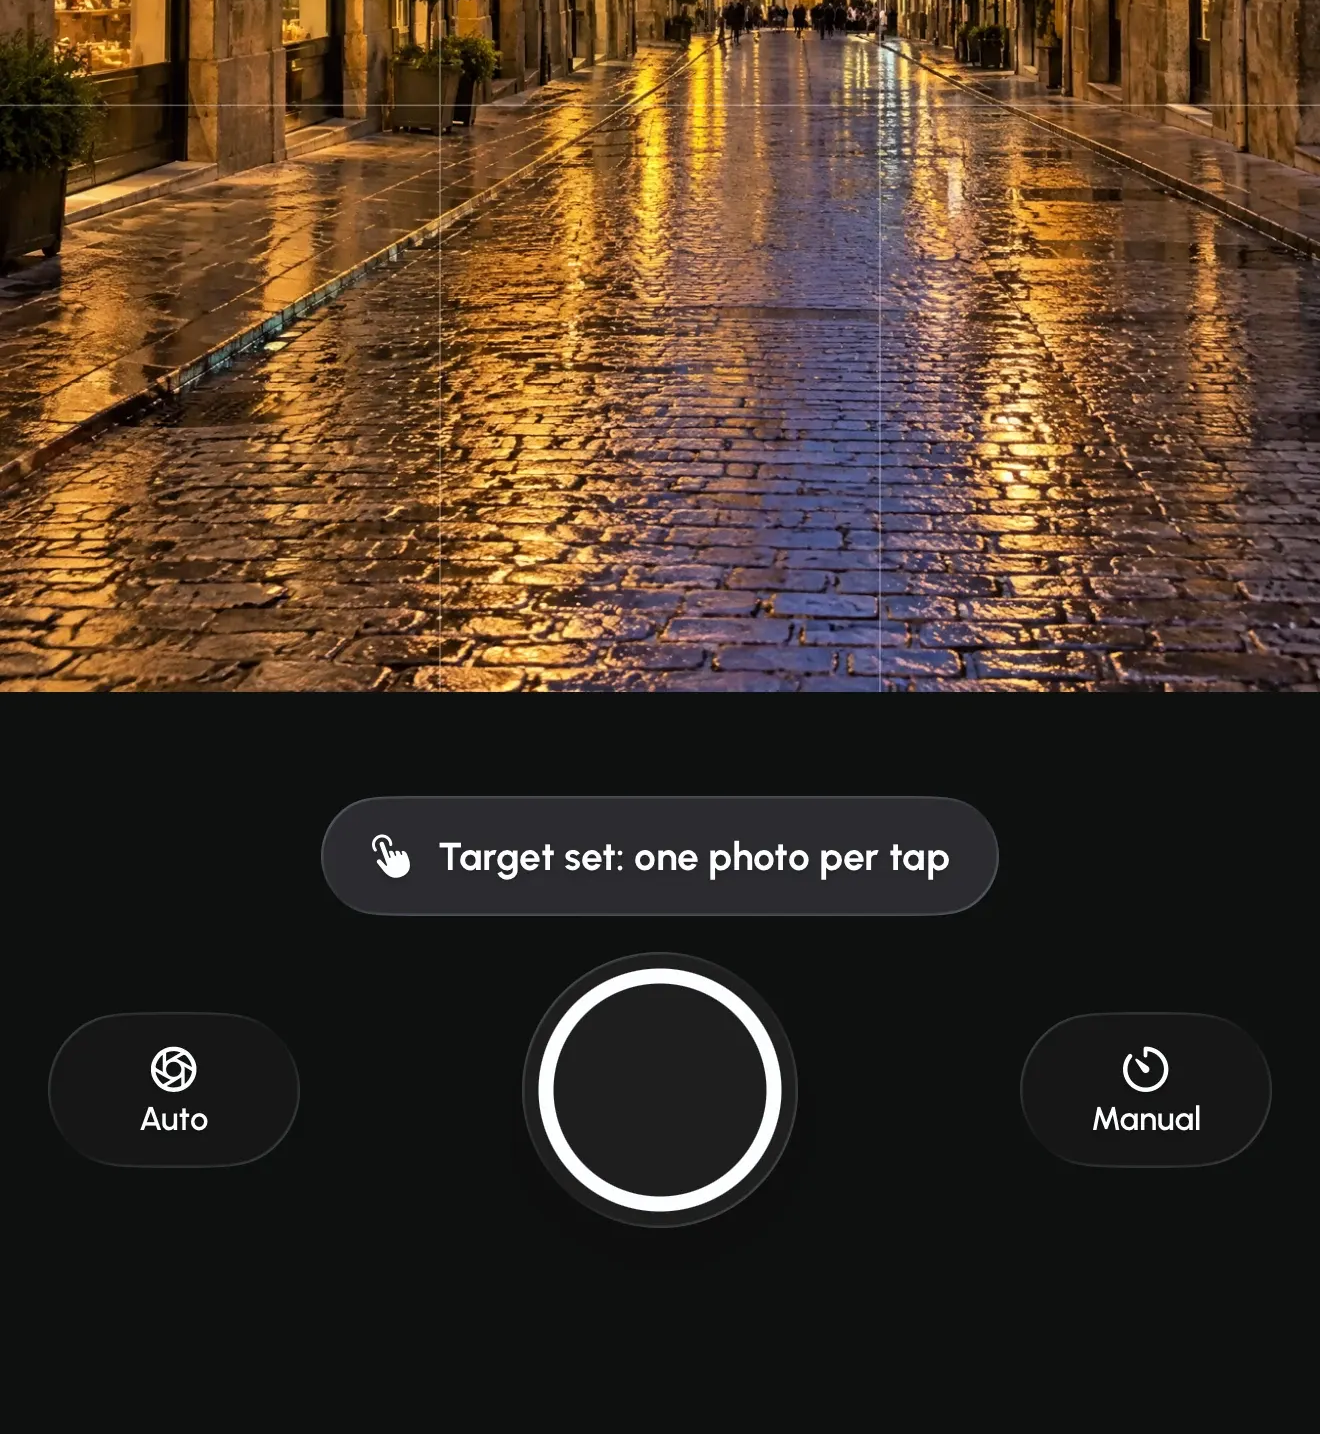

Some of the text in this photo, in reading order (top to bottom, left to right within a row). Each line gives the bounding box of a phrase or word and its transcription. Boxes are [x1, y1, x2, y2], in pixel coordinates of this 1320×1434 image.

[438, 840, 950, 881] Target set: one photo per tap
[139, 1106, 209, 1131] Auto
[1092, 1104, 1200, 1131] Manual
